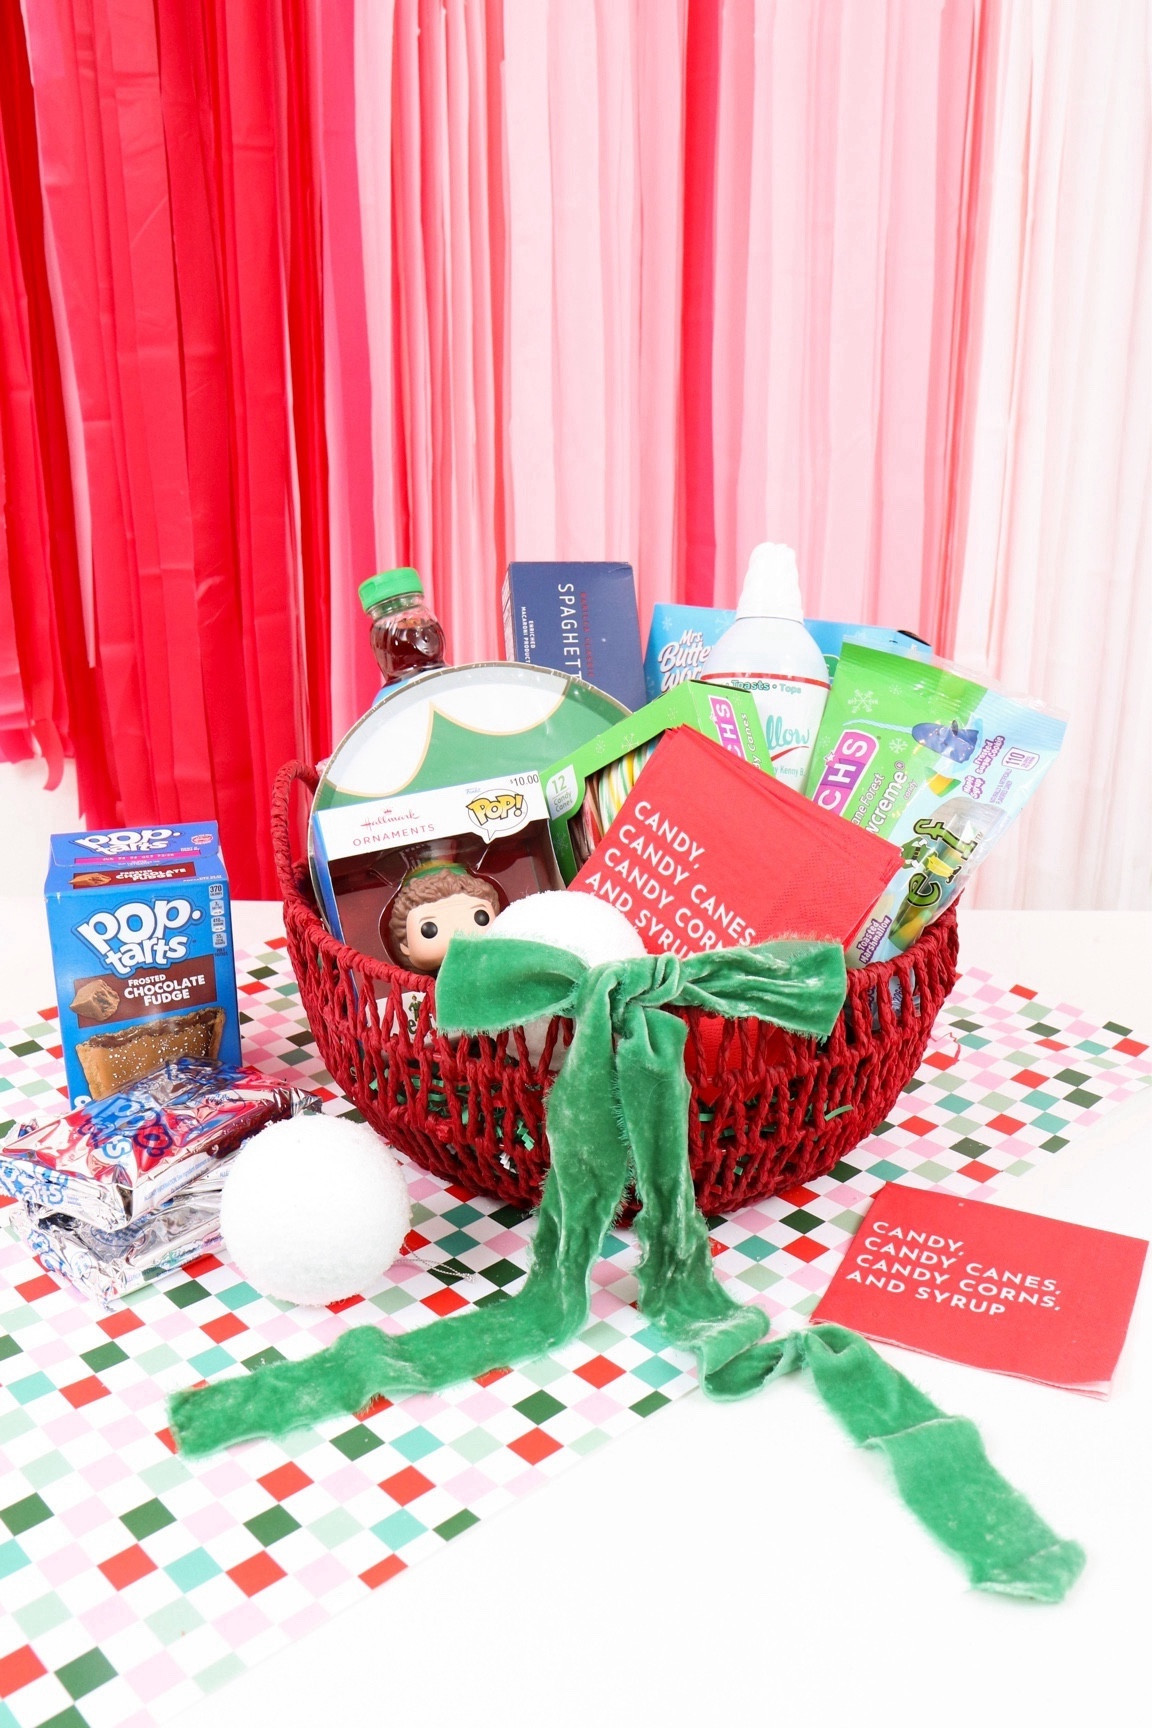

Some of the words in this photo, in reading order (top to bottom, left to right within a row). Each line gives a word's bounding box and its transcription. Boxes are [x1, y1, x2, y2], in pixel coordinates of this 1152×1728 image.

[520, 606, 529, 636] MACARONI
[528, 620, 536, 649] ENRICHED
[679, 628, 704, 647] Mrs.
[741, 712, 756, 752] Canes
[1006, 751, 1025, 765] 110
[510, 774, 539, 786] $10.00
[552, 775, 567, 794] 12
[859, 772, 885, 808] Forest
[352, 823, 435, 847] ORNAMENTS
[361, 809, 420, 831] Hallmark
[634, 801, 705, 869] CANDY,
[618, 824, 690, 886] CANDY
[210, 885, 222, 893] 370
[585, 871, 633, 912] AND
[604, 848, 675, 909] CANDY
[857, 919, 879, 950] Toasted
[860, 917, 892, 963] Marshmallow
[105, 936, 188, 974] tarts
[124, 975, 206, 999] CHOCOLATE
[128, 974, 166, 987] FROSTED
[143, 989, 190, 1007] FUDGE
[872, 1221, 964, 1256] CANDY,
[864, 1237, 957, 1269] CANDY
[965, 1262, 1061, 1295] CANES,
[845, 1270, 905, 1293] AND
[914, 1287, 1006, 1316] SYRUP
[856, 1254, 950, 1285] CANDY
[958, 1279, 1061, 1311] CORNS,
